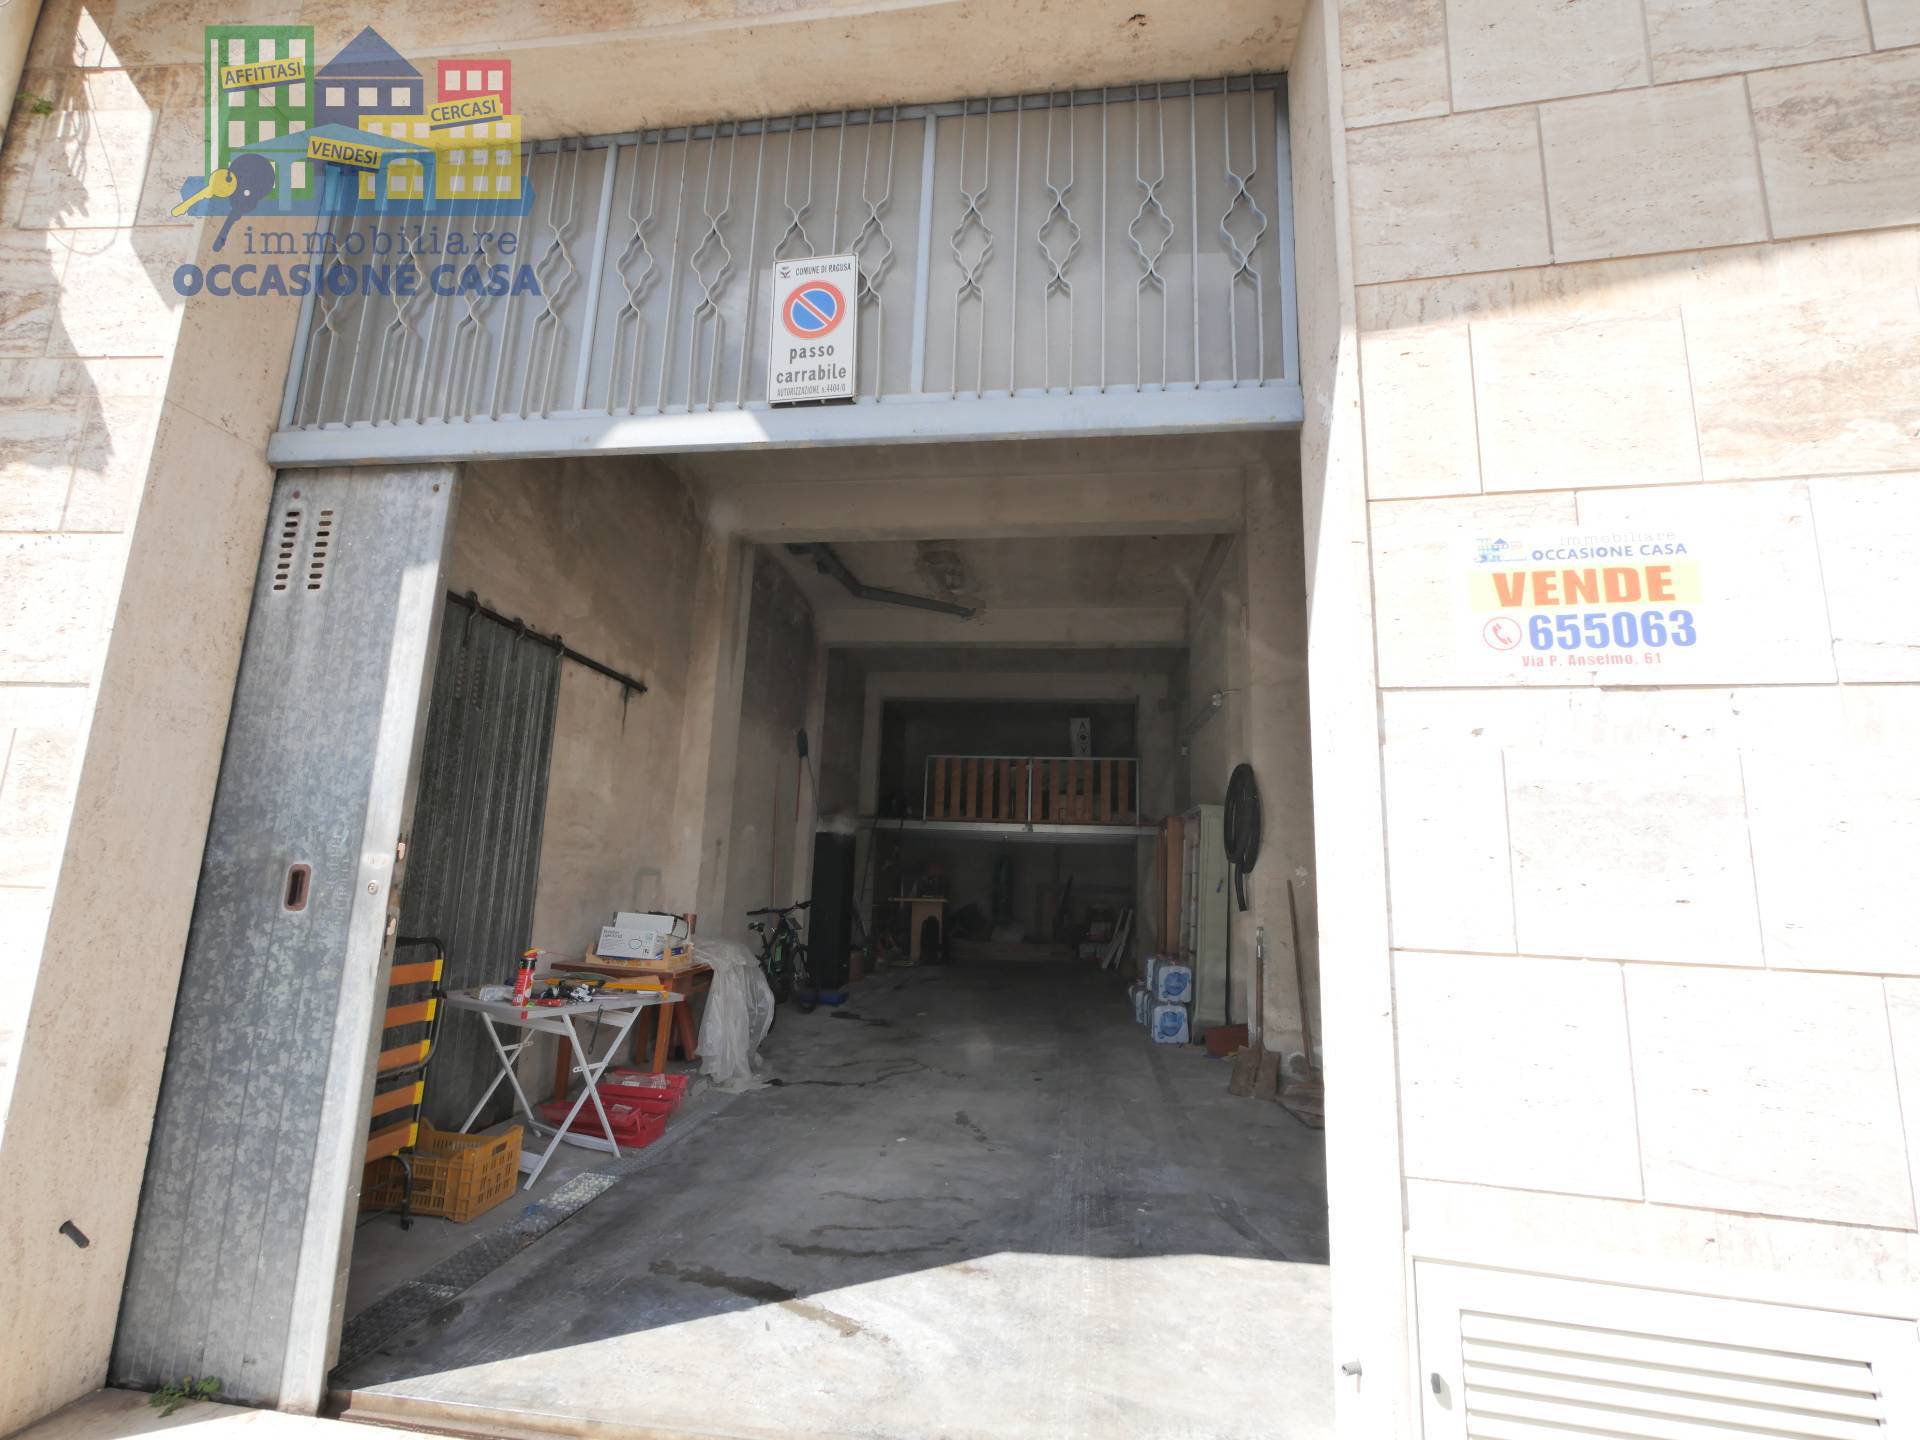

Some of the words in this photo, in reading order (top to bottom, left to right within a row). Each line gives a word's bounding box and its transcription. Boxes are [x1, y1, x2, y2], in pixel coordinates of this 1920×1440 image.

[795, 265, 820, 276] COMUNE
[820, 264, 828, 274] DI
[828, 263, 851, 272] RAGUSA
[789, 345, 835, 364] passo
[776, 363, 847, 384] carrabile
[1532, 545, 1634, 561] OCCASIONE
[1639, 543, 1688, 557] CASA
[1491, 565, 1676, 608] VENDE
[1528, 609, 1697, 651] 655063
[1521, 655, 1544, 667] Via
[1549, 655, 1563, 667] P.
[1644, 652, 1662, 664] 61
